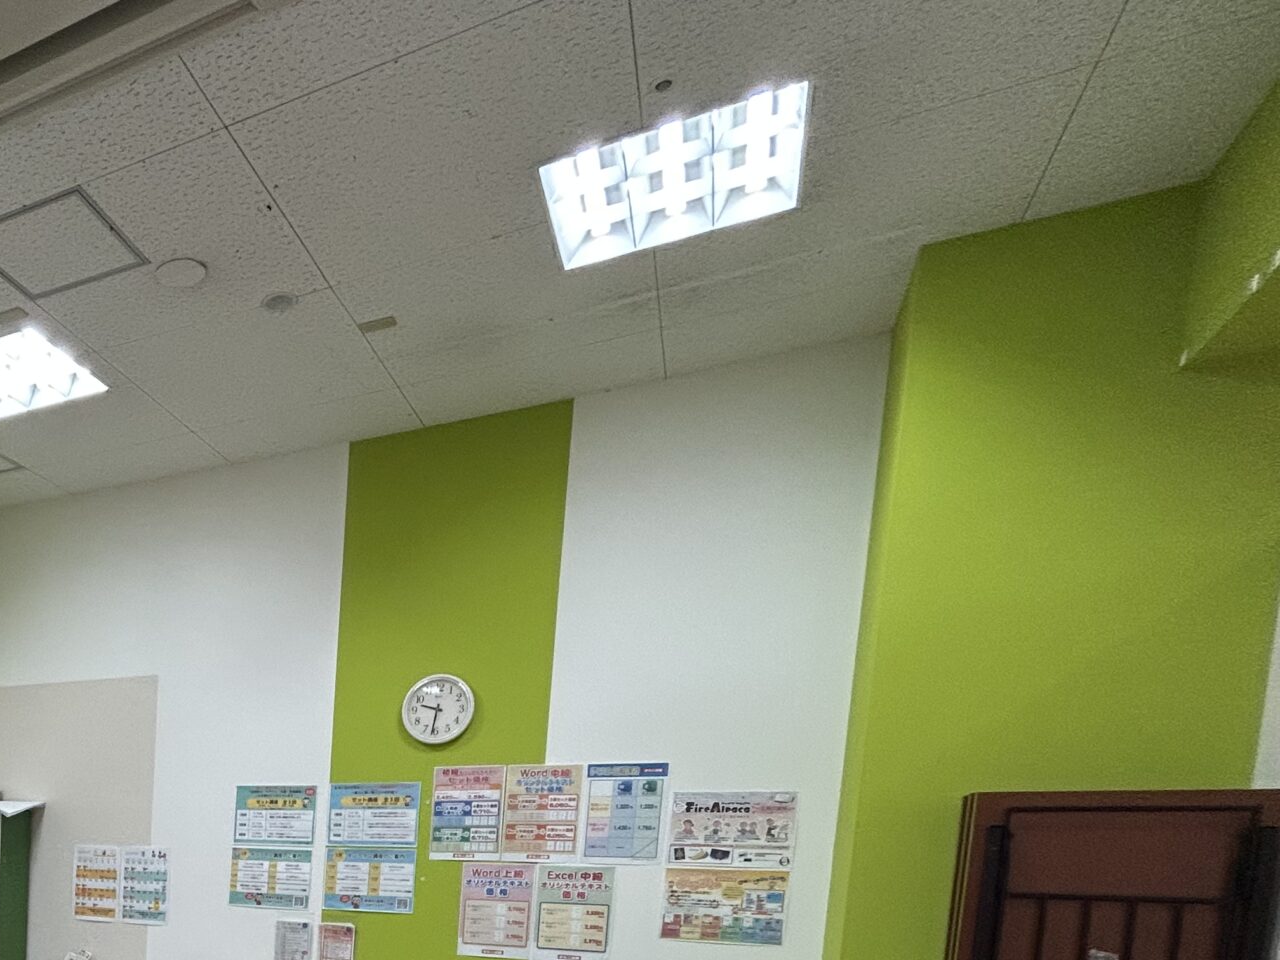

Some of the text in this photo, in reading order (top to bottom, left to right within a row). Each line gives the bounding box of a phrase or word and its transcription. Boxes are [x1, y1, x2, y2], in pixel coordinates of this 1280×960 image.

[449, 686, 453, 694] 1
[416, 695, 424, 703] 10
[456, 693, 462, 702] 2
[412, 706, 417, 714] 9
[459, 705, 464, 713] 3
[414, 717, 420, 725] 8
[454, 716, 459, 724] 4
[422, 725, 429, 733] 7
[445, 724, 450, 733] 5
[520, 768, 571, 778] Word 中級
[685, 801, 750, 813] FireAlpaca
[472, 868, 524, 879] Word 上級
[548, 870, 603, 881] Excel 中級
[541, 882, 610, 890] オリジナルテキスト
